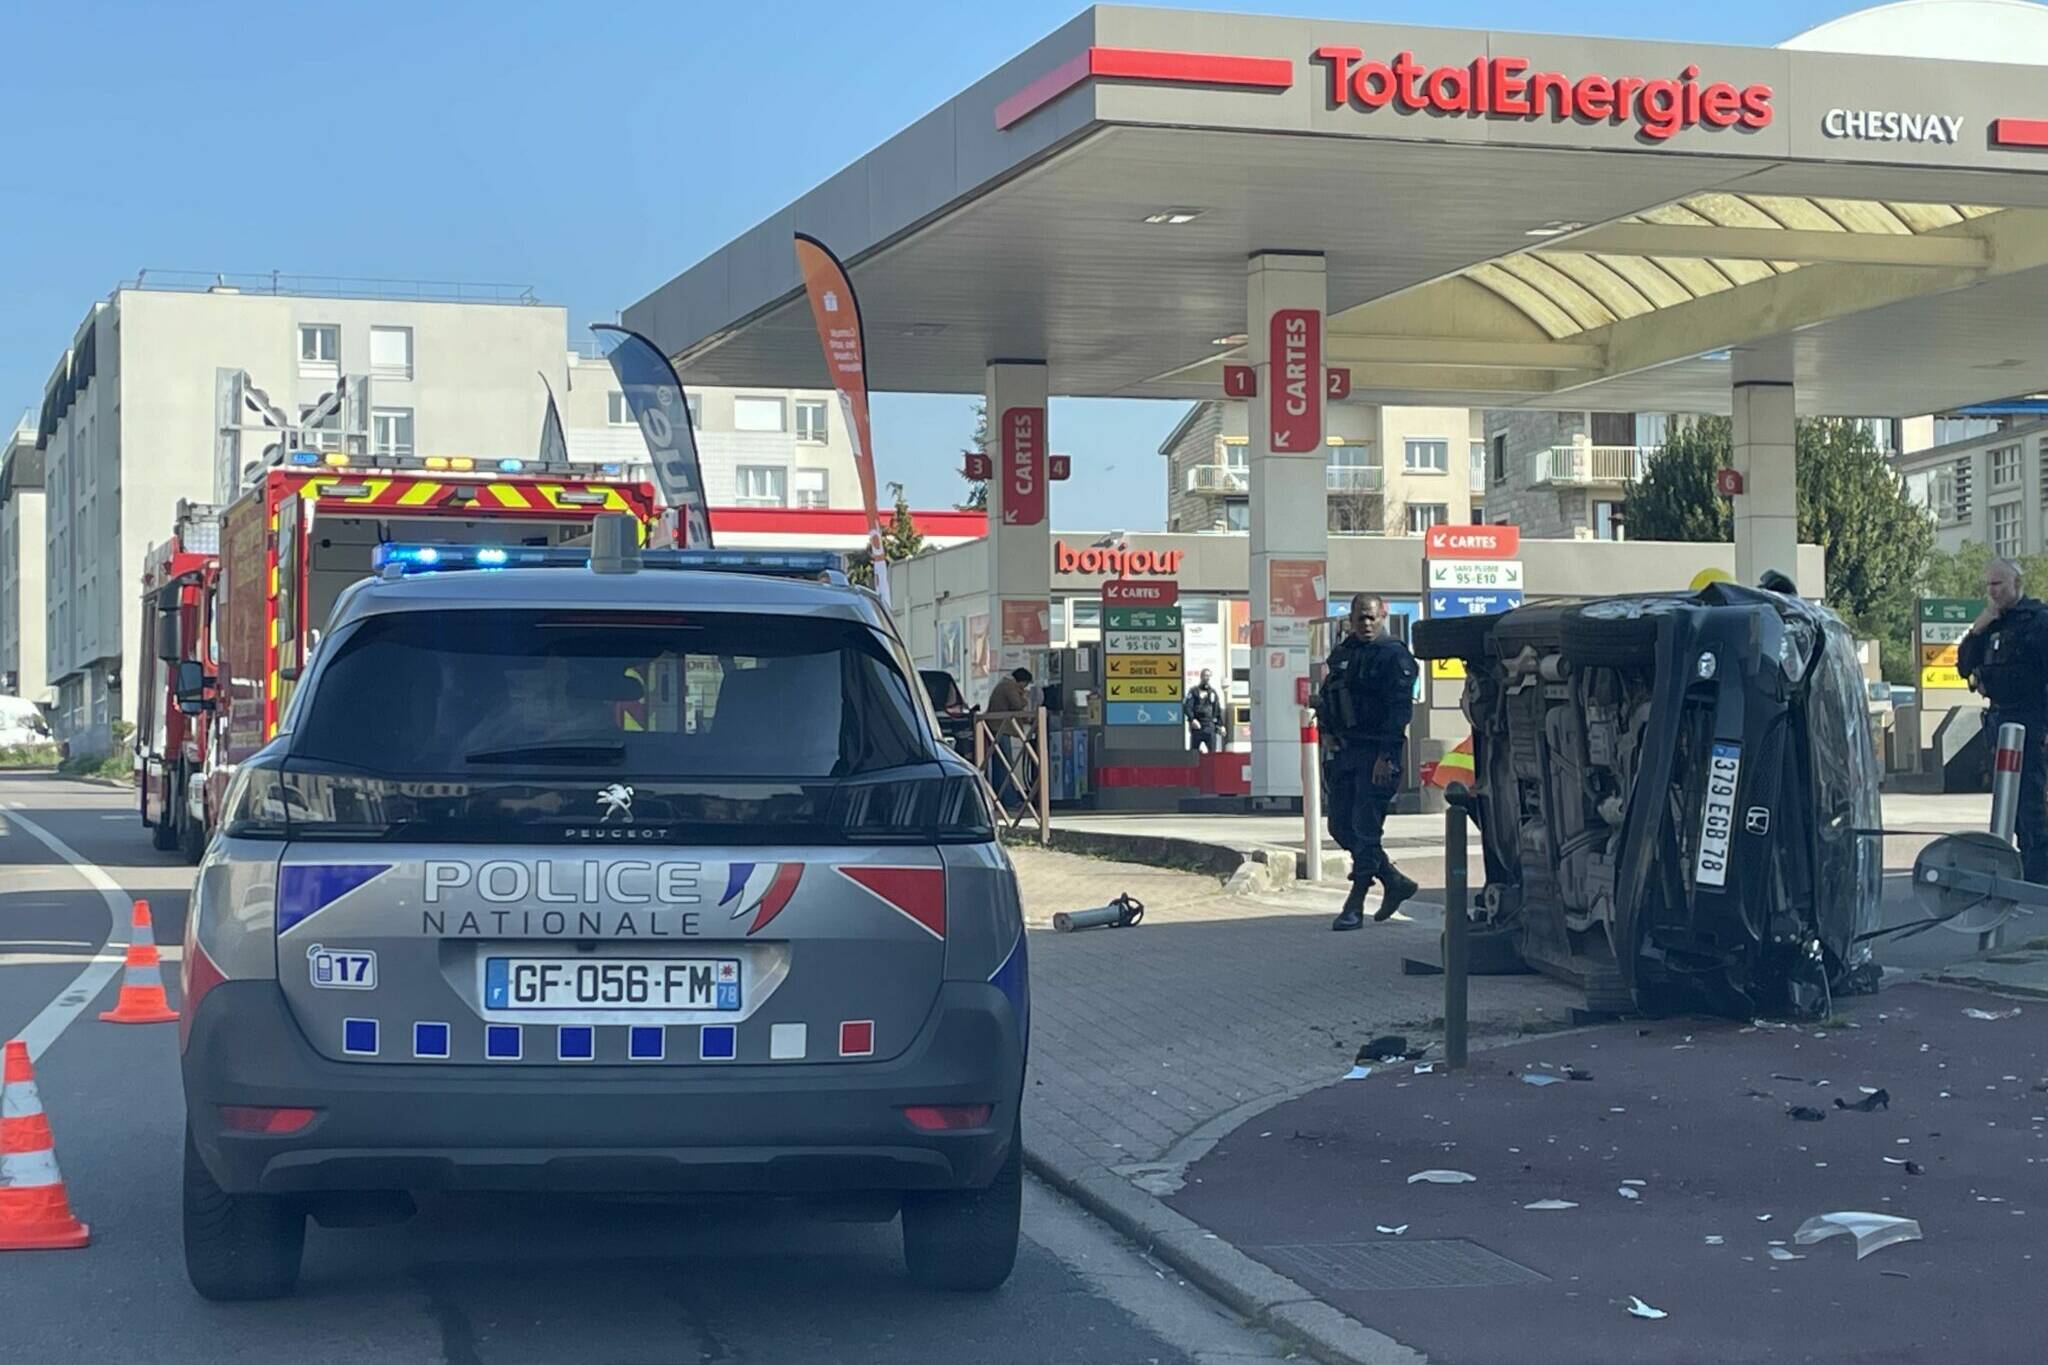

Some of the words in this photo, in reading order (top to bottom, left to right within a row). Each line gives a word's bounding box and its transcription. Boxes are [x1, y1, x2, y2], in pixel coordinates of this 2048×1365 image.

[1316, 45, 1774, 139] TotalEnergies
[1824, 107, 1965, 143] CHESNAY
[1286, 318, 1306, 415] CARTES
[1235, 372, 1245, 390] 1
[1329, 374, 1342, 393] 2
[1015, 414, 1033, 495] CARTES
[974, 458, 984, 475] 3
[1053, 460, 1064, 475] 4
[1725, 475, 1735, 490] 6
[1450, 536, 1497, 549] CARTES
[1058, 541, 1183, 580] bonjour
[1456, 573, 1497, 584] 95-E10
[1121, 587, 1160, 598] CARTES
[1127, 641, 1160, 651] 95-E10
[1130, 666, 1158, 675] DIESEL
[1130, 686, 1158, 695] DIESEL
[1711, 759, 1736, 797] 379
[1705, 802, 1731, 840] EGB
[565, 828, 668, 839] PEUGEOT
[1701, 849, 1725, 871] 78
[424, 860, 702, 903] POLICE
[423, 911, 701, 936] NATIONALE
[335, 956, 370, 983] 17
[513, 964, 712, 1004] GF-056-FM
[719, 985, 737, 1003] 78
